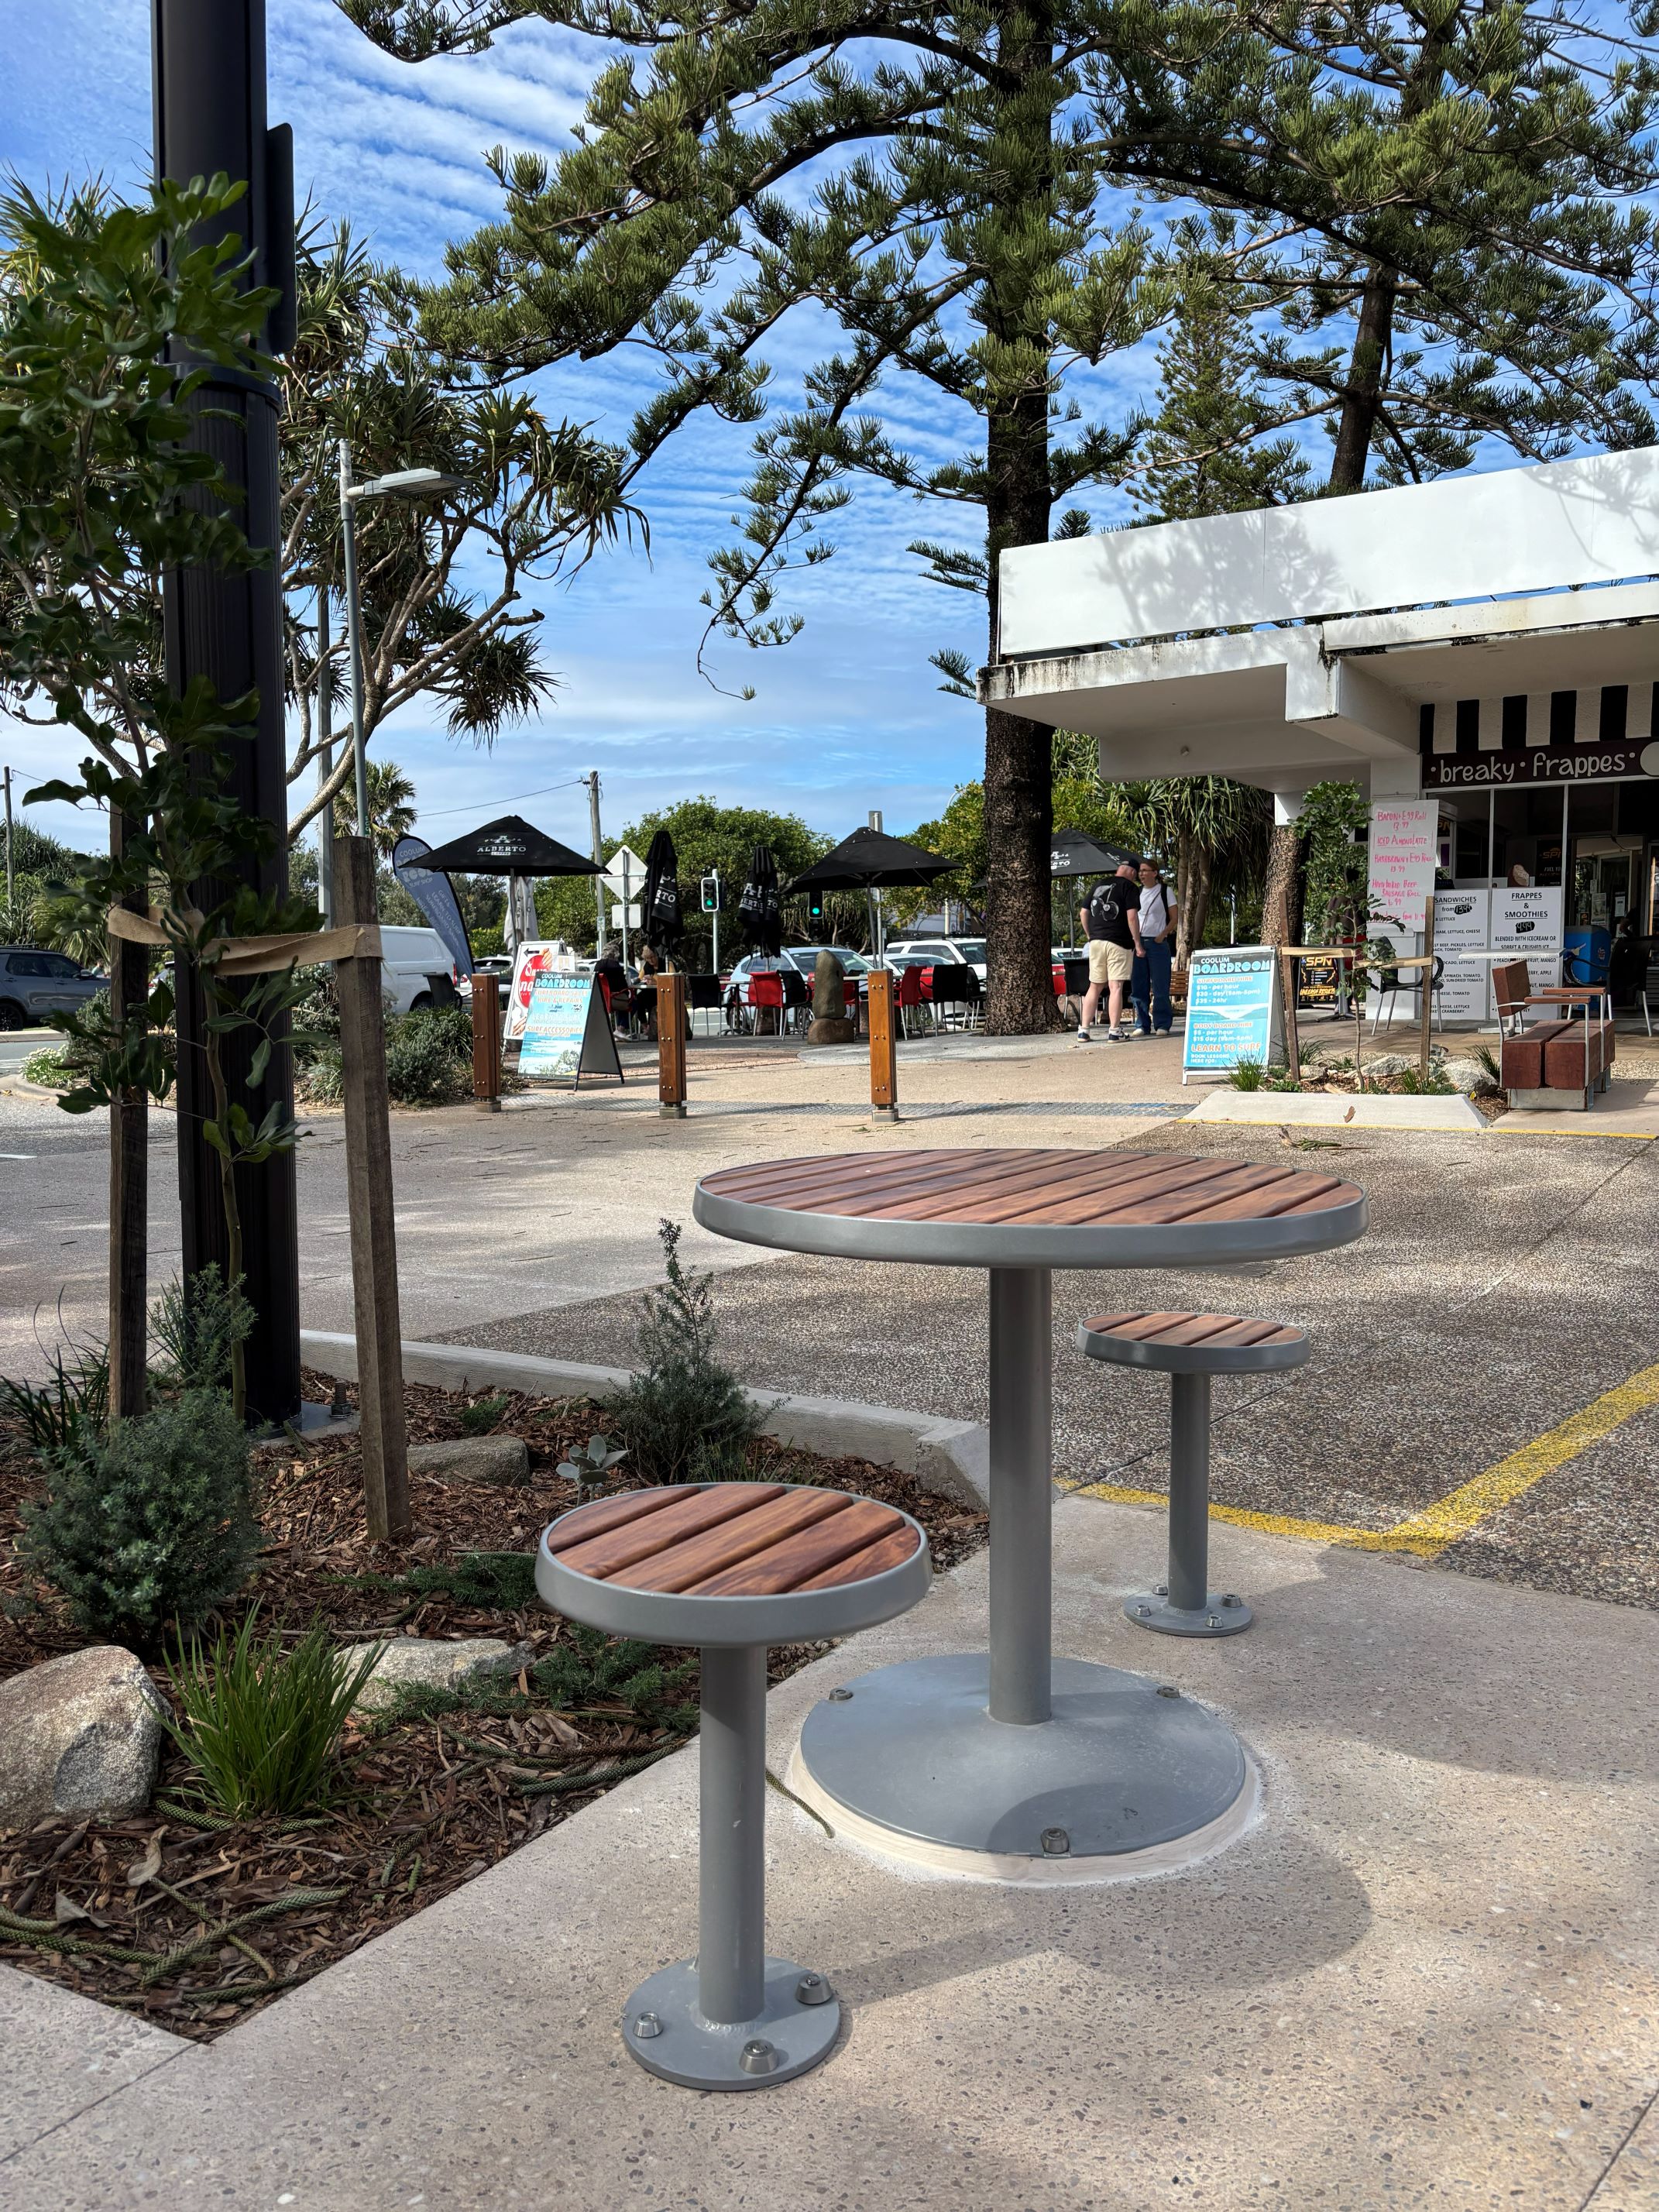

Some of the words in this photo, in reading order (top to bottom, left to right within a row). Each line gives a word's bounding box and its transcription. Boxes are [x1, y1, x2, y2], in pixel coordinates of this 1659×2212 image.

[1440, 756, 1515, 783] breaky
[1533, 752, 1626, 778] frappes
[1194, 960, 1270, 974] BOARDROOM
[1306, 957, 1332, 967] SPN
[535, 978, 590, 988] BOARDROOM
[1238, 1042, 1261, 1051] SURF
